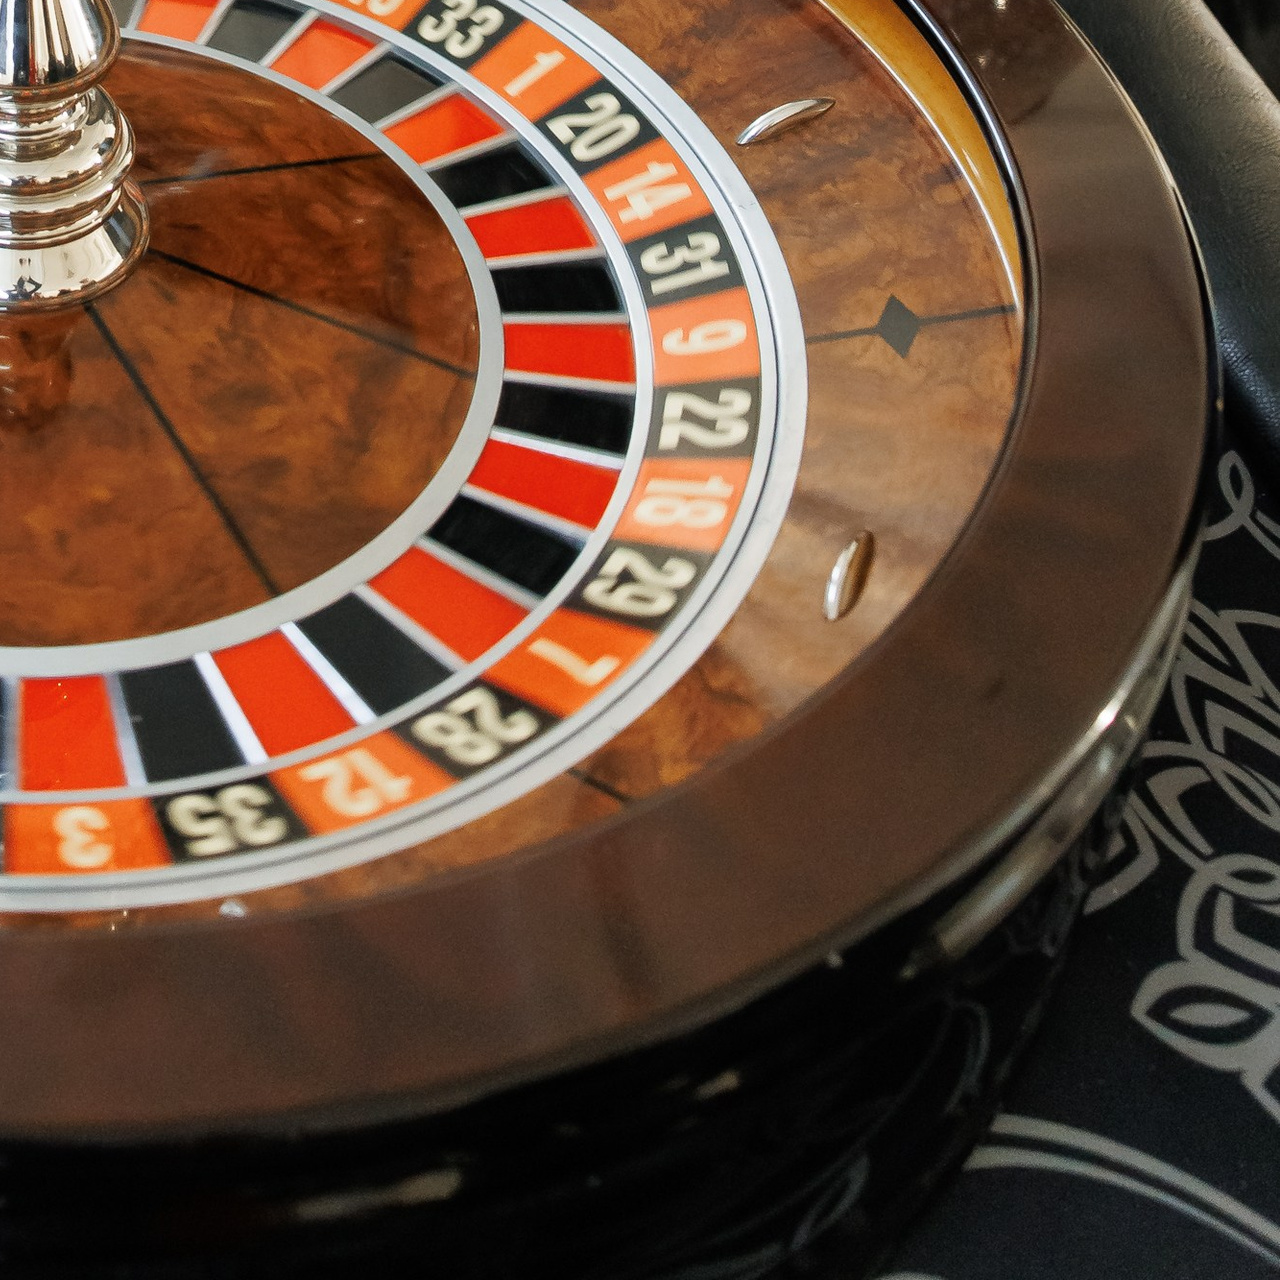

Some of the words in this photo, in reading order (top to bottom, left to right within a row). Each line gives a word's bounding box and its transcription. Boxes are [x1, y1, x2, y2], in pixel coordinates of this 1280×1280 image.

[505, 51, 565, 96] 1
[546, 93, 639, 162] 20
[604, 161, 691, 224] 14
[640, 234, 729, 295] 31
[662, 320, 747, 356] 9
[662, 389, 751, 450] 22
[634, 476, 734, 529] 18
[584, 548, 696, 615] 29
[529, 638, 621, 686] 7
[411, 687, 539, 765] 28
[300, 749, 413, 816] 12
[54, 806, 114, 868] 3
[167, 783, 287, 856] 35
